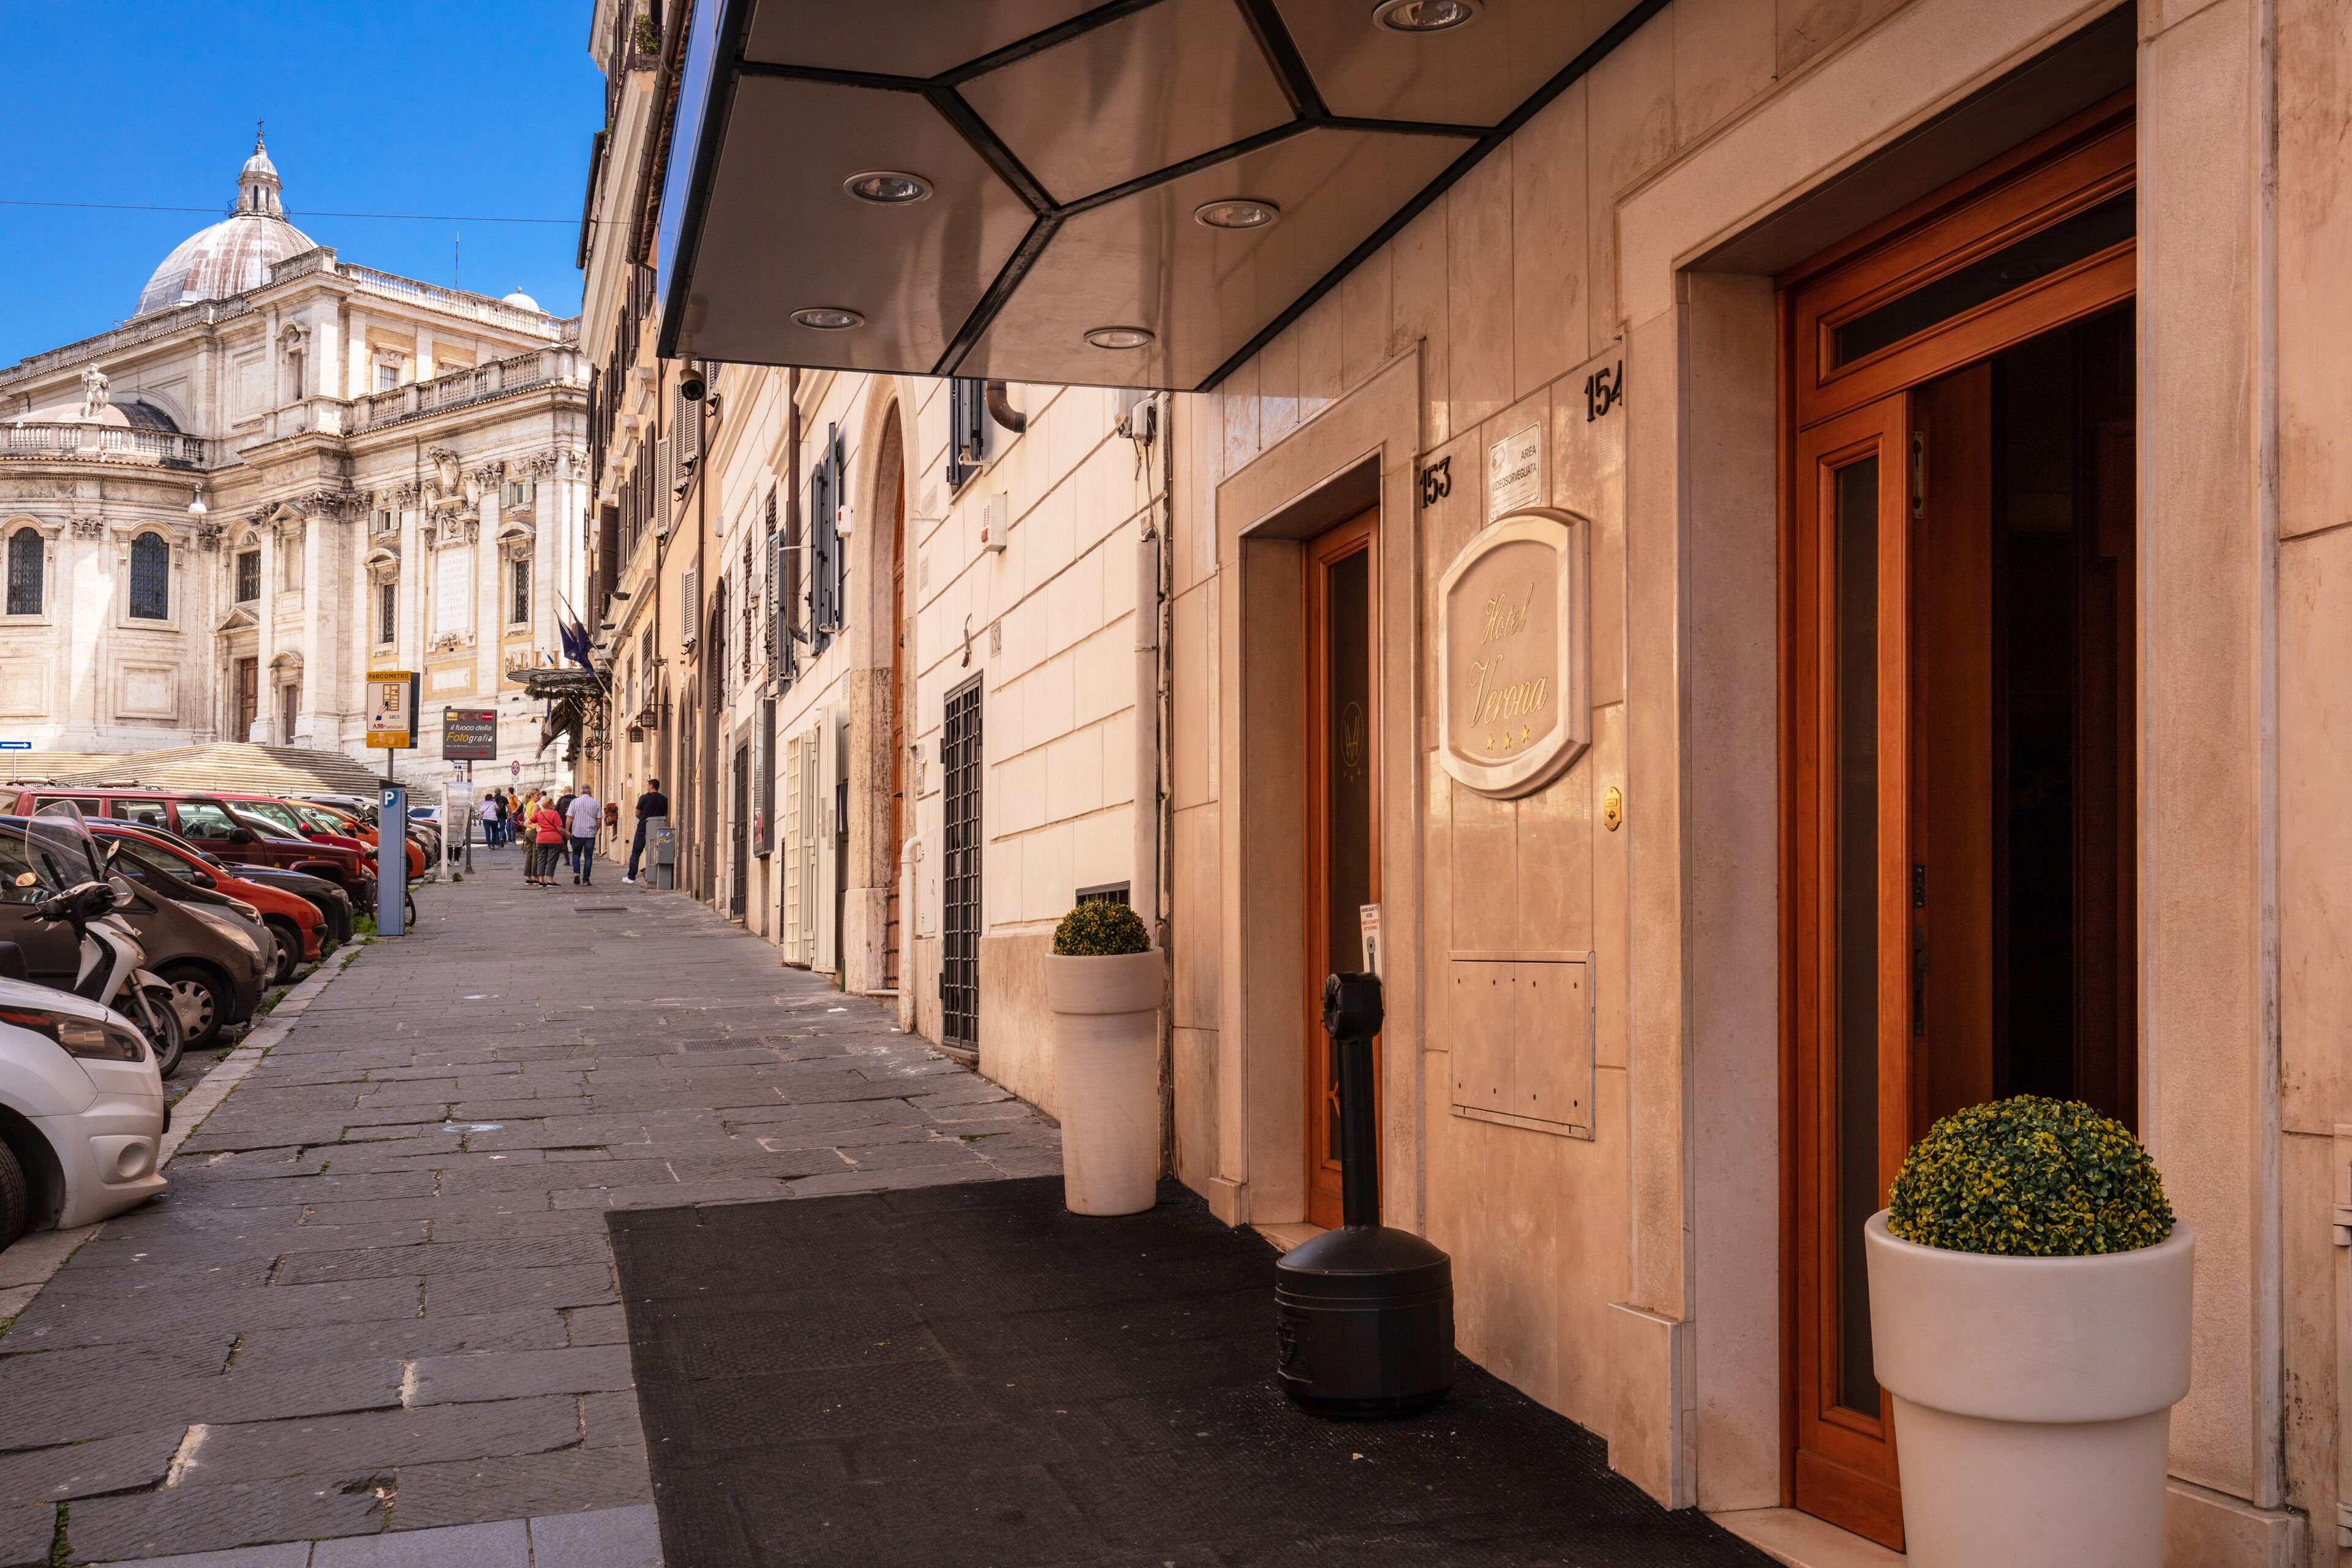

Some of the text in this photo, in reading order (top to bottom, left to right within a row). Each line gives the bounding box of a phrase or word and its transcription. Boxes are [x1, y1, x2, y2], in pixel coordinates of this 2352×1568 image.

[1584, 360, 1622, 422] 154
[1520, 445, 1536, 461] AREA
[1420, 456, 1451, 509] 153
[1492, 462, 1536, 492] VIDEOSORVEGLIATA
[1481, 582, 1533, 644] Hotel
[1469, 653, 1548, 728] Verona
[446, 732, 493, 743] Fotografia
[384, 791, 394, 805] P
